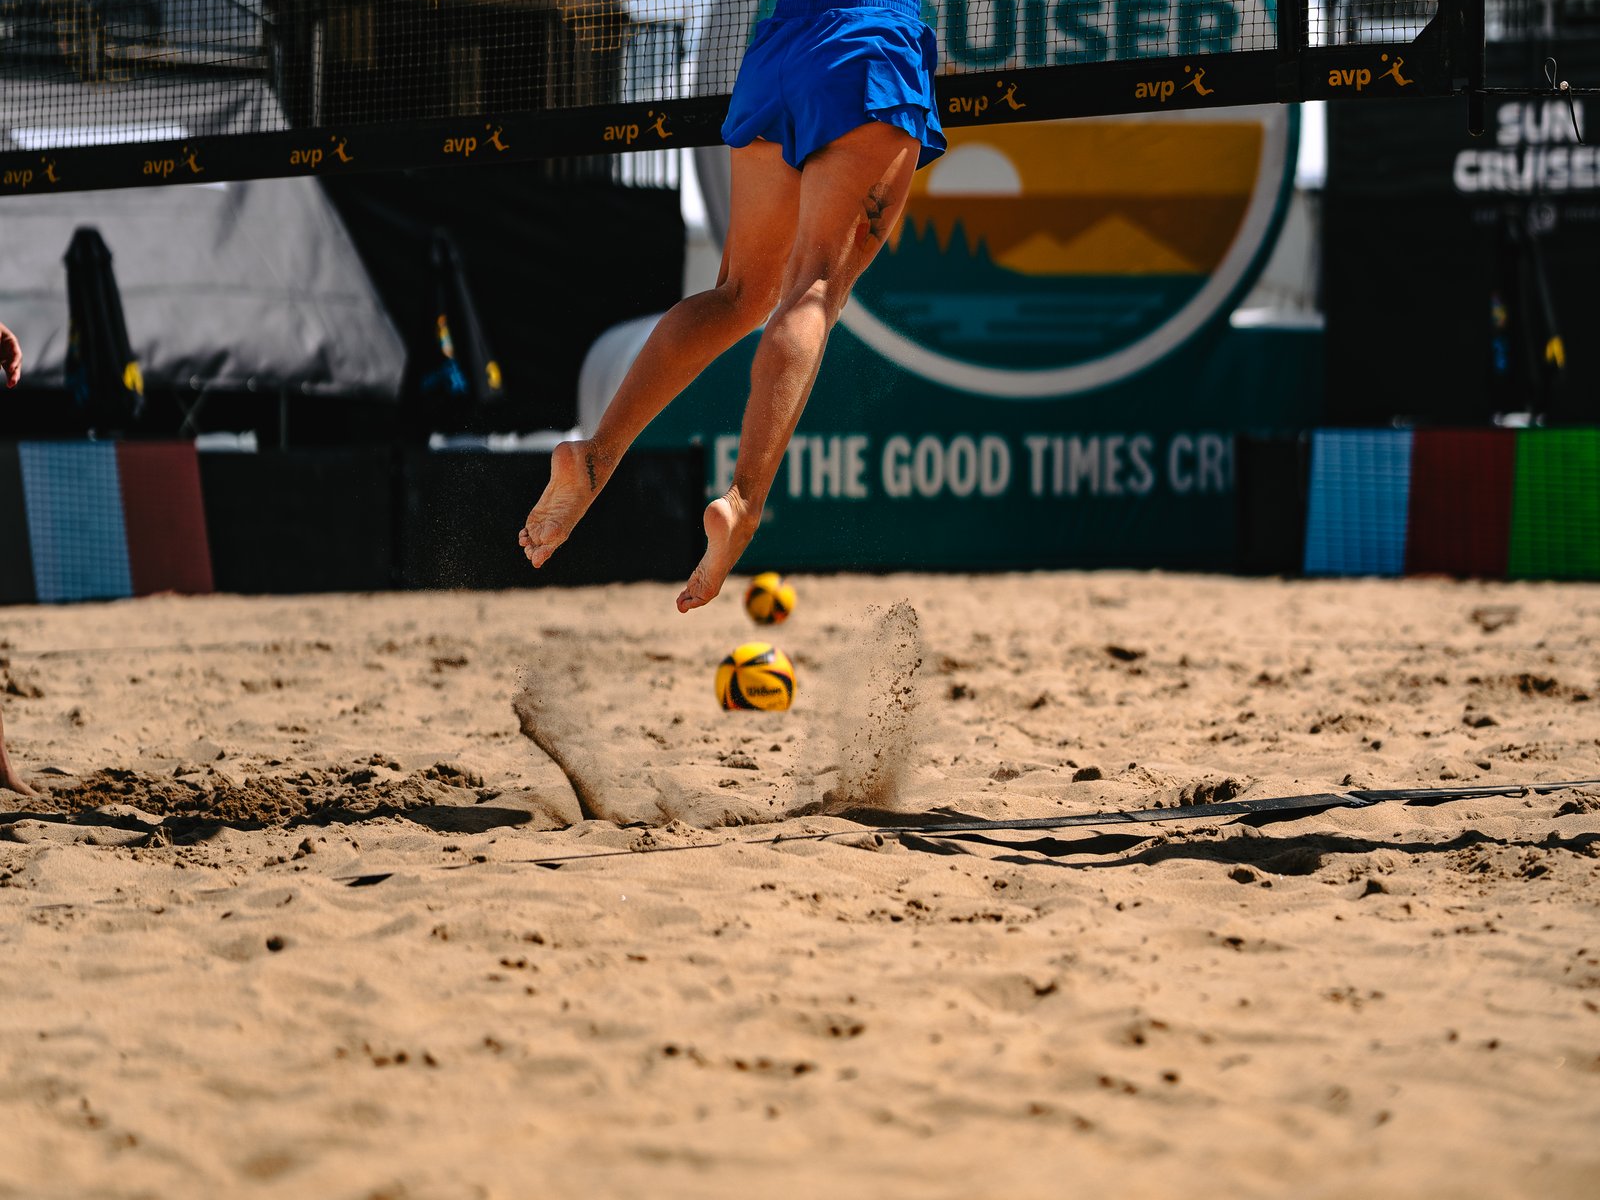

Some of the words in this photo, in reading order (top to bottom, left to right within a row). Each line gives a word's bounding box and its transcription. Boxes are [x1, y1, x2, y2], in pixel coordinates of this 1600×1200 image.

[1328, 68, 1371, 90] avp
[1135, 80, 1175, 101] avp
[948, 95, 989, 117] avp
[1496, 100, 1585, 146] SUN
[443, 135, 477, 156] avp
[603, 124, 639, 145] avp
[143, 156, 174, 177] avp
[289, 146, 323, 168] avp
[3, 167, 34, 188] avp
[1453, 147, 1600, 194] CRUISE
[787, 433, 868, 497] THE
[882, 434, 1011, 498] GOOD
[1024, 433, 1153, 497] TIMES
